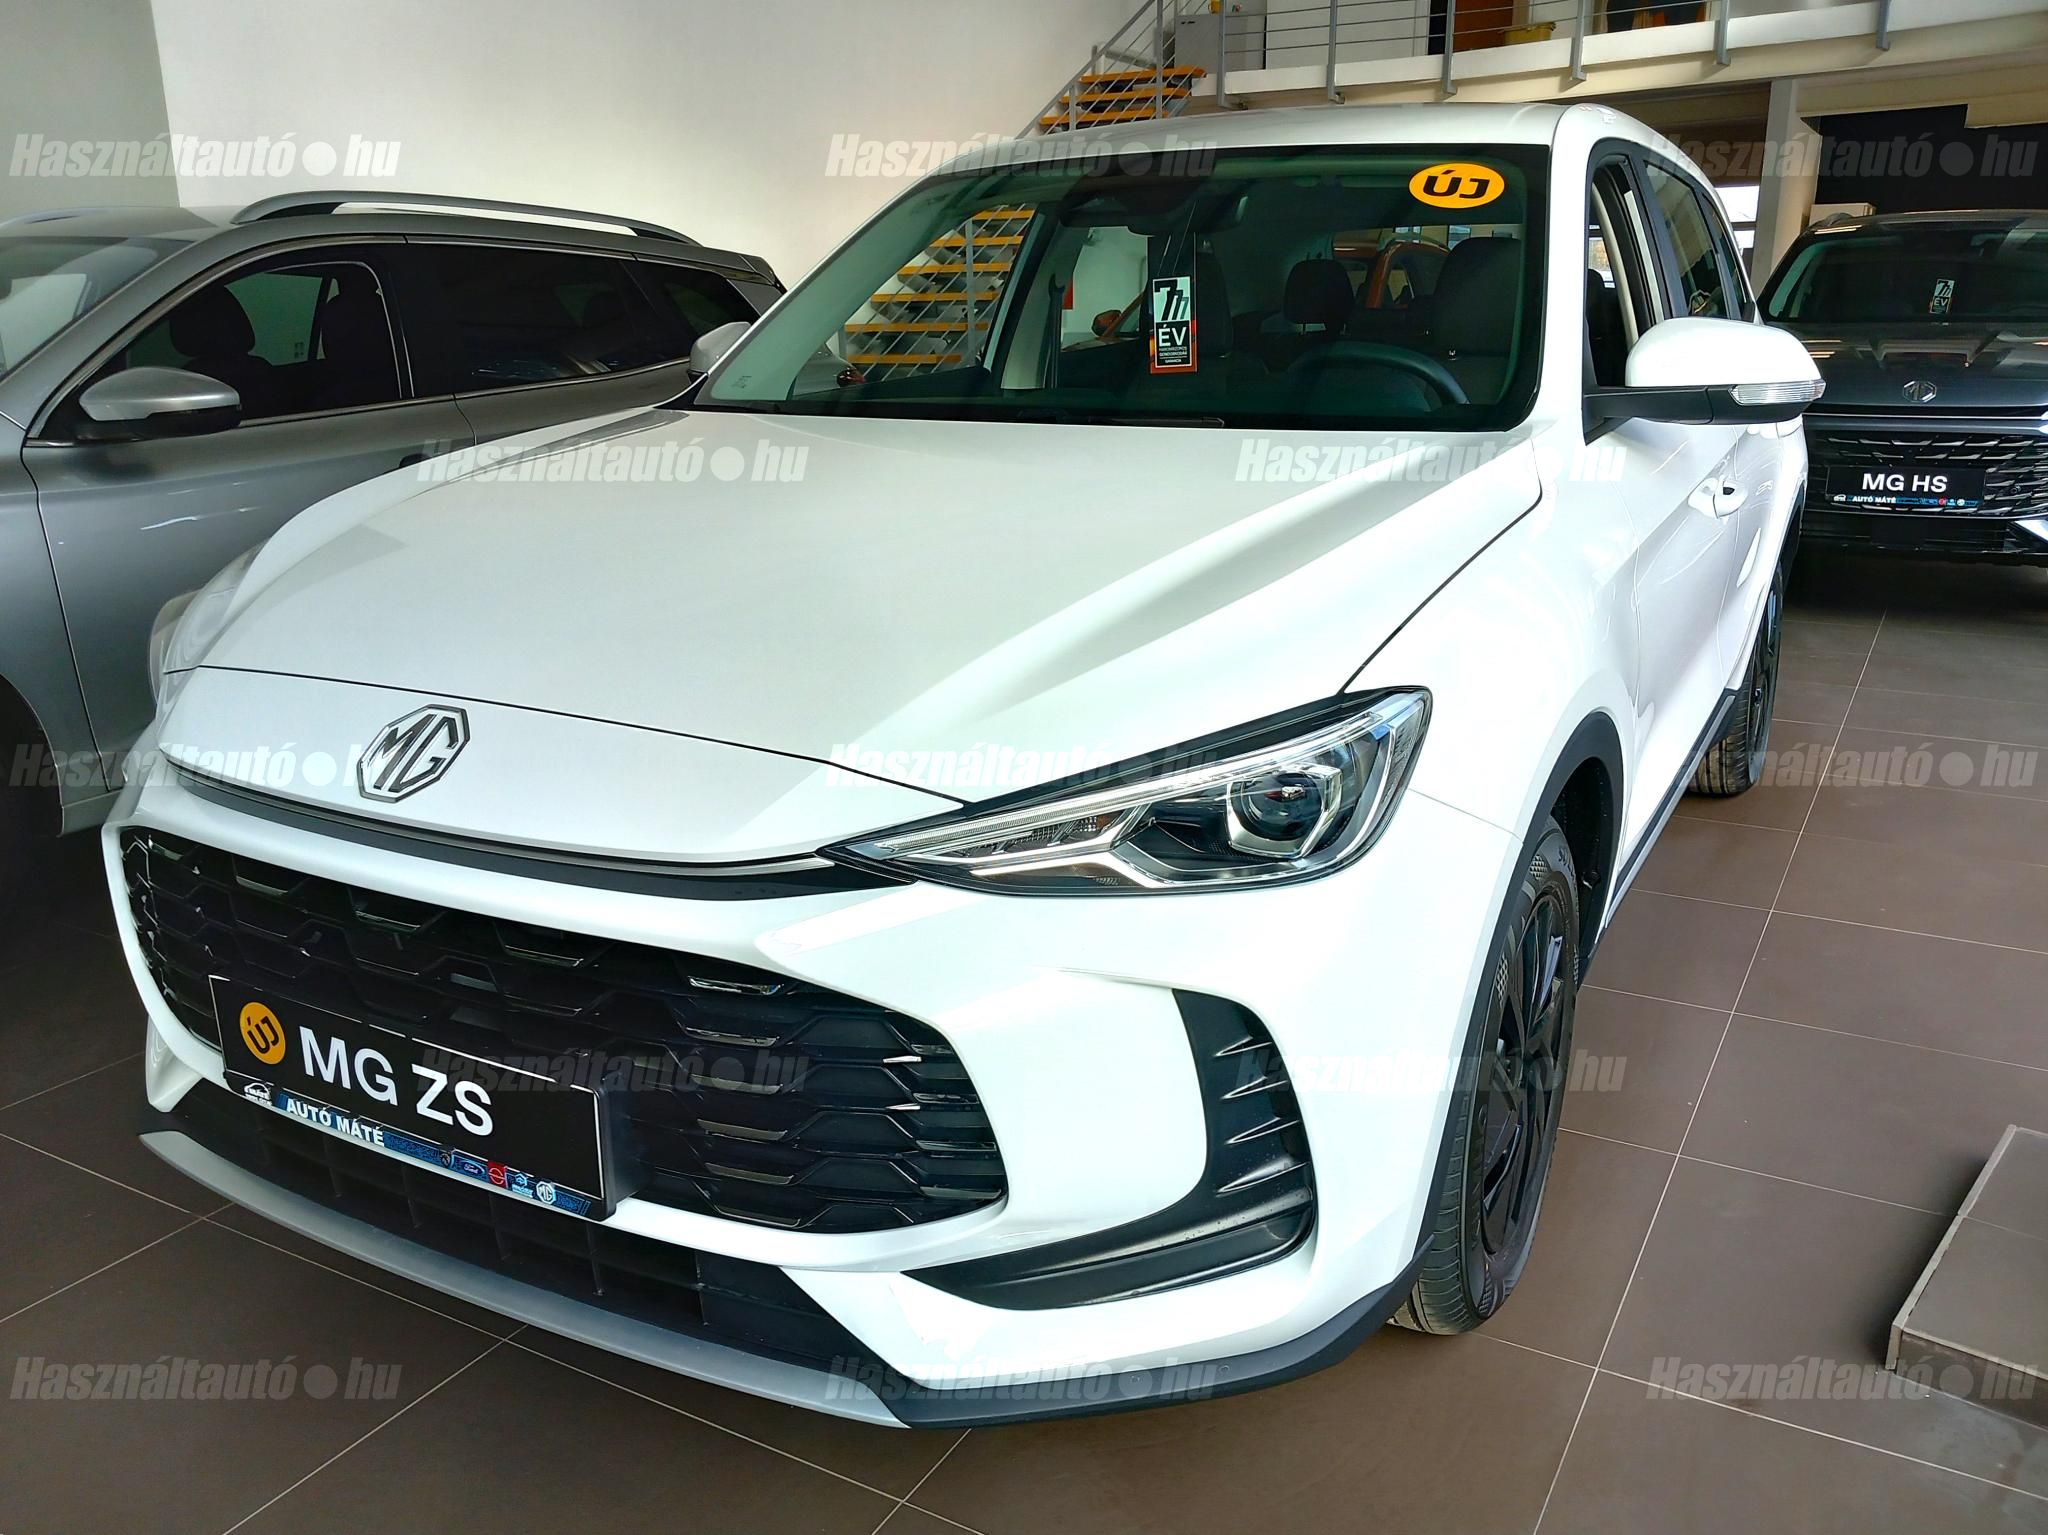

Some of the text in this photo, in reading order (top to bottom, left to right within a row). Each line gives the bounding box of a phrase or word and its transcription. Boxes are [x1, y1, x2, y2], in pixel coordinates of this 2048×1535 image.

[1423, 169, 1490, 199] ÚJ
[1158, 324, 1187, 347] ÉV
[1862, 473, 1948, 493] MG HS
[363, 709, 465, 798] MG
[246, 1015, 280, 1055] ÚJ
[299, 1026, 494, 1136] MG ZS
[286, 1098, 385, 1147] AUTÓ MÁTÉ
[537, 1182, 556, 1204] MG
